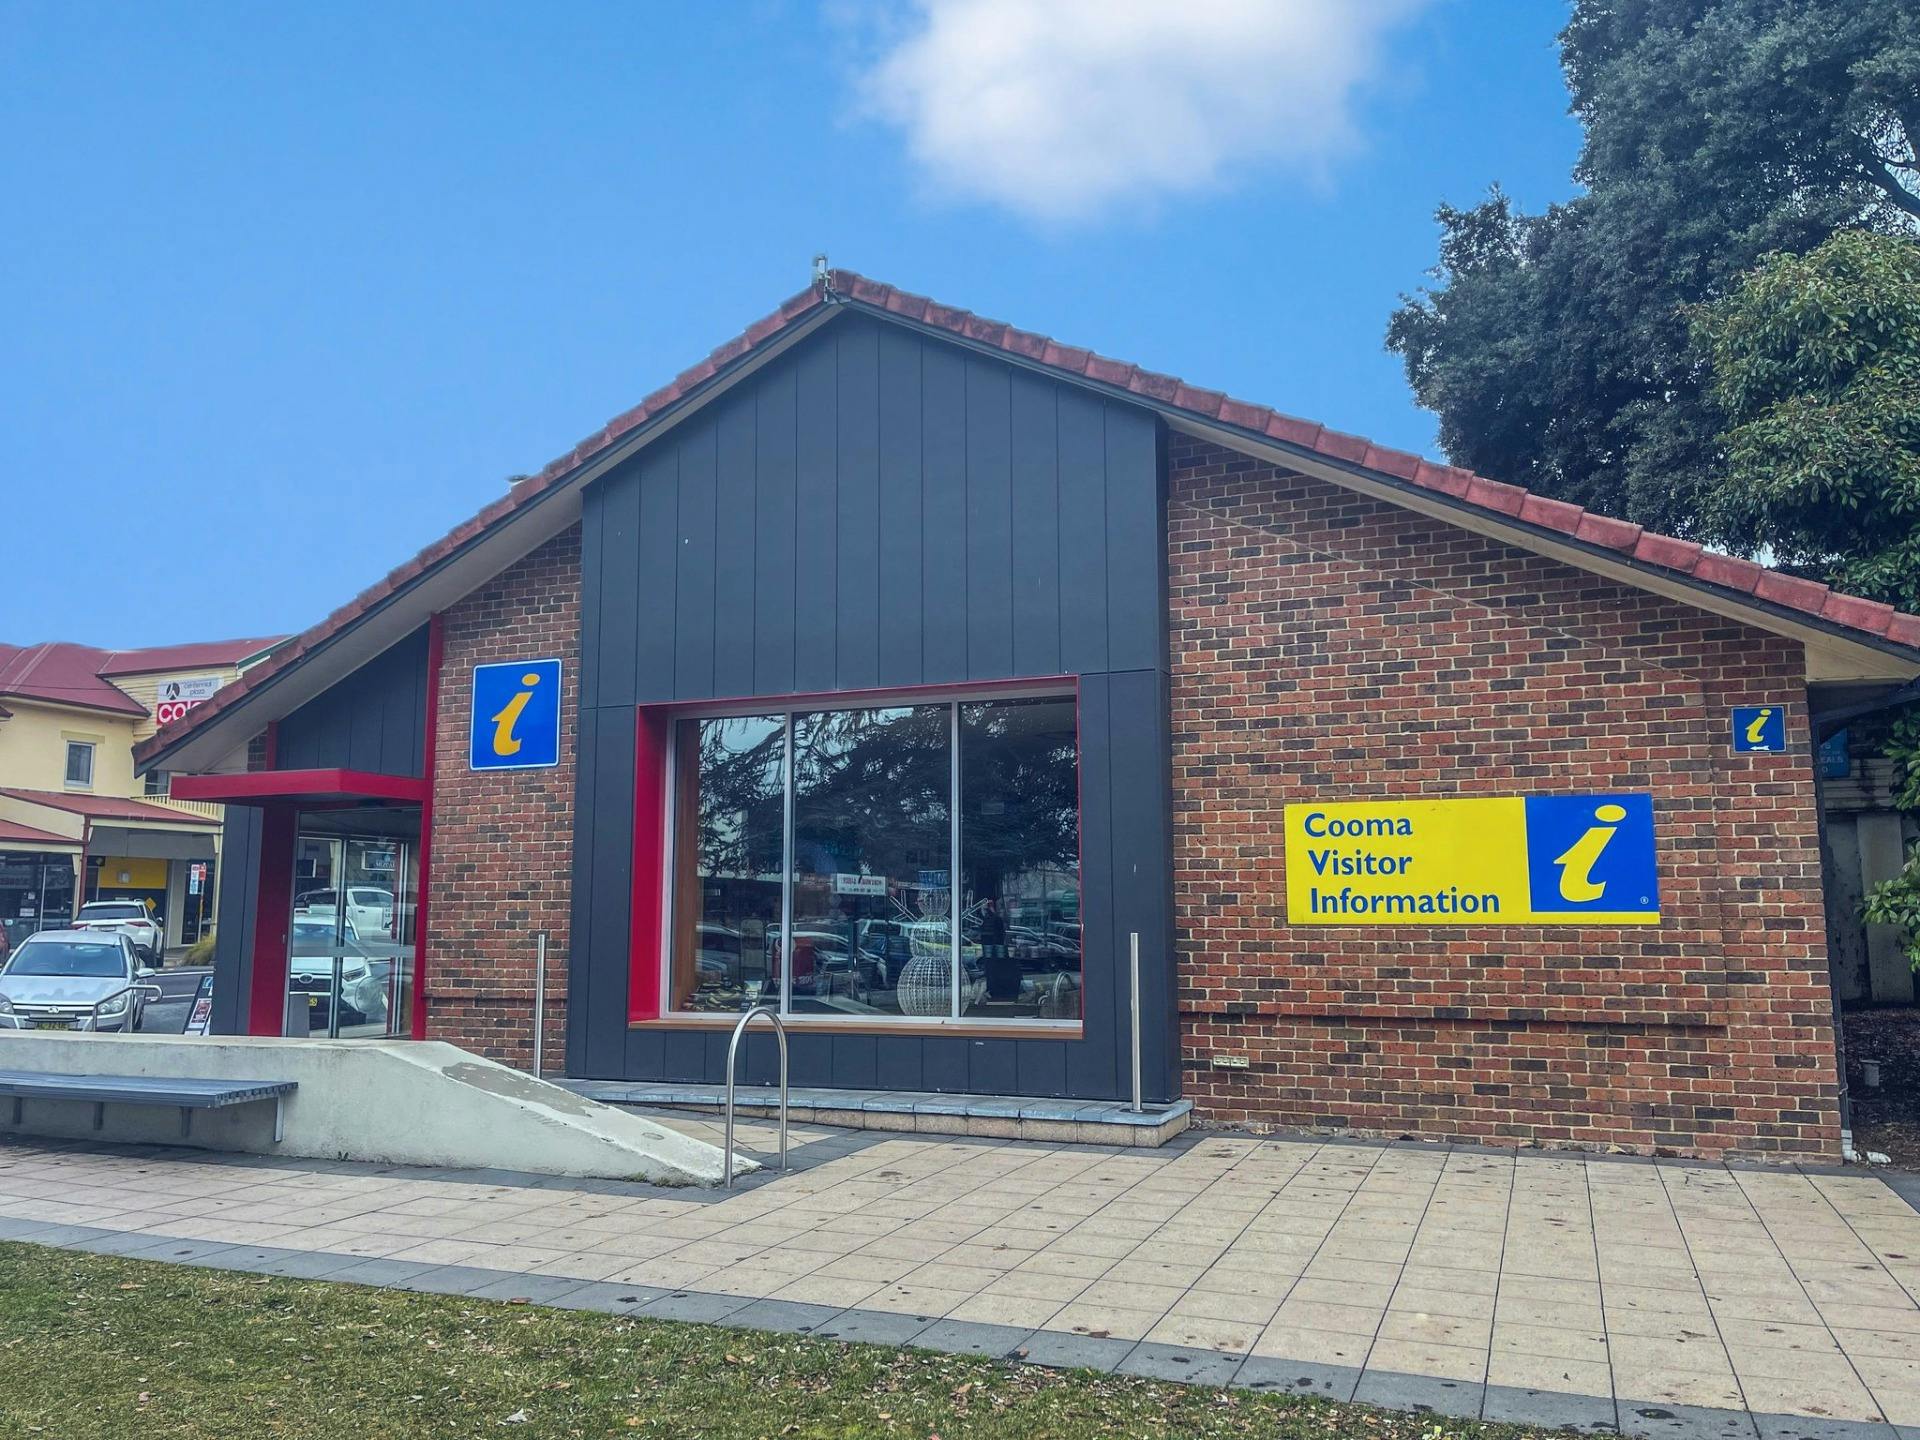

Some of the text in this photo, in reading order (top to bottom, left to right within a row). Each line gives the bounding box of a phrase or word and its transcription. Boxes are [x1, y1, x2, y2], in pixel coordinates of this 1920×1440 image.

[1303, 812, 1413, 838] Cooma
[1308, 848, 1413, 876] Visitor
[1310, 886, 1500, 914] Information
